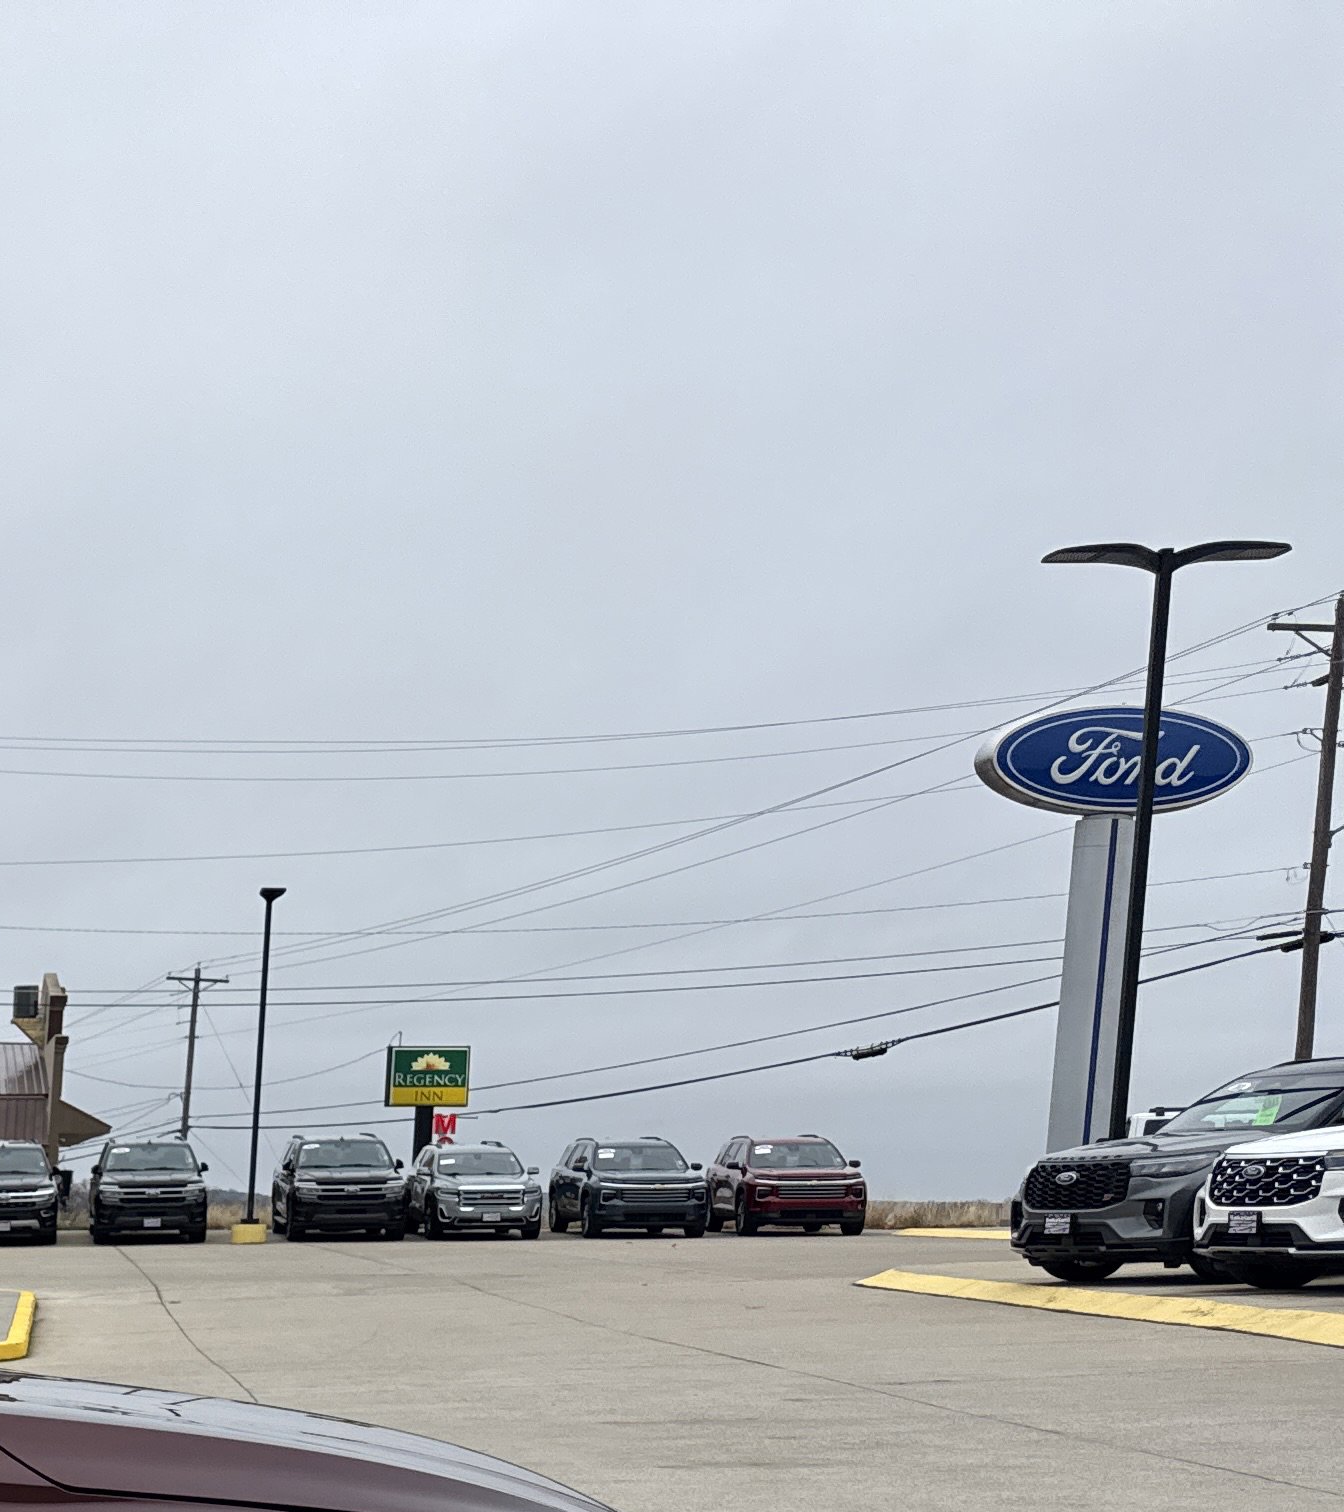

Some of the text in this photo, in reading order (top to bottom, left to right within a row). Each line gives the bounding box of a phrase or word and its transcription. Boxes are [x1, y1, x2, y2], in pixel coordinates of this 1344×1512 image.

[1050, 726, 1201, 787] Ford
[394, 1072, 465, 1086] REGENCY
[414, 1090, 444, 1102] INN
